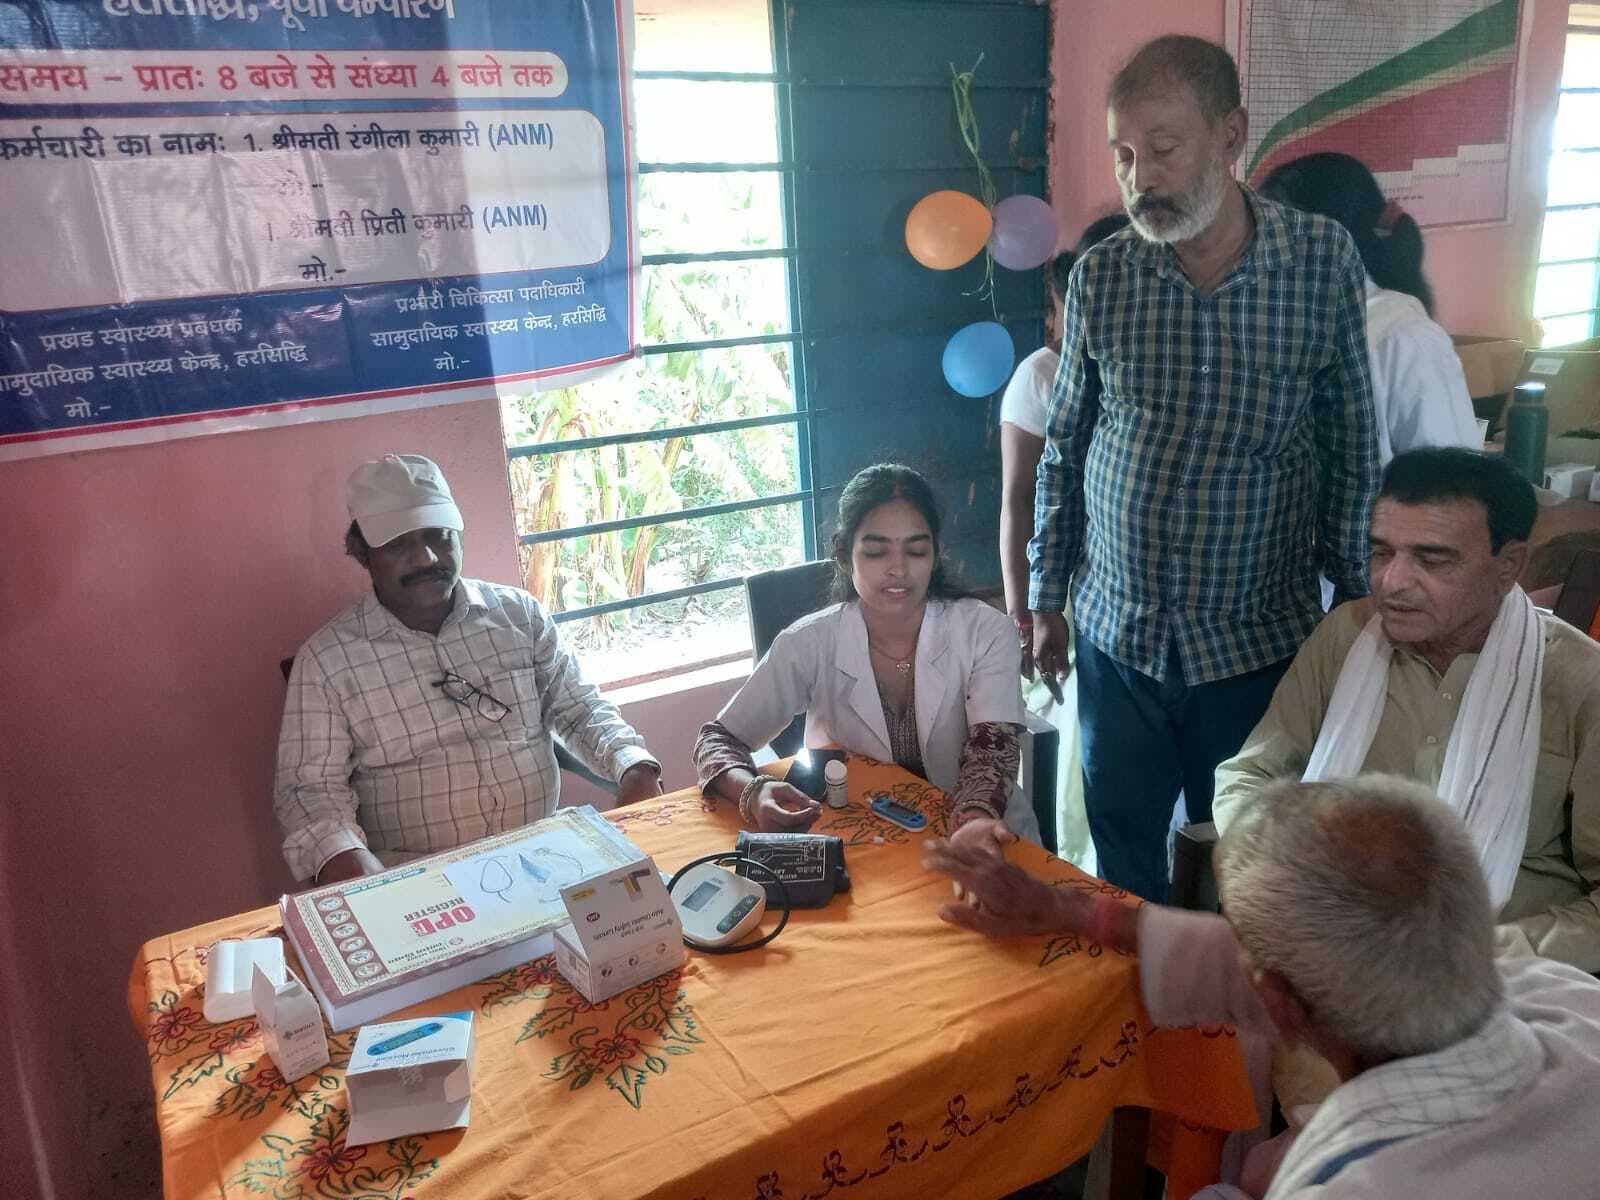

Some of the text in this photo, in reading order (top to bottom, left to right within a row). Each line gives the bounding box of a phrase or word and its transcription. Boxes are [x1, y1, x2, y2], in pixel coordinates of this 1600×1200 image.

[0, 65, 87, 91] समय
[217, 66, 237, 90] 8
[246, 54, 298, 90] बजे
[307, 54, 335, 88] से
[347, 56, 416, 88] संध्या
[431, 66, 449, 87] 4
[458, 55, 502, 87] बजे
[511, 65, 553, 87] तक
[0, 126, 106, 160] कर्मचारी
[114, 135, 150, 156] का
[243, 134, 263, 152] 1.
[272, 124, 339, 151] श्रीमती
[346, 123, 410, 149] रंगीला
[419, 120, 480, 155] कुमारी
[488, 123, 553, 151] (ANM)
[361, 207, 407, 238] प्रिती
[413, 205, 474, 239] कुमारी
[483, 204, 547, 233] (ANM)
[395, 290, 444, 313] प्रभारी
[519, 277, 585, 301] पदाधिकारी
[370, 321, 458, 350] सामुदायिक
[463, 318, 518, 338] स्वास्थ्य
[0, 362, 94, 397] ामुदायिक
[100, 357, 173, 381] स्वास्थ्य
[403, 896, 466, 922] REGISTER
